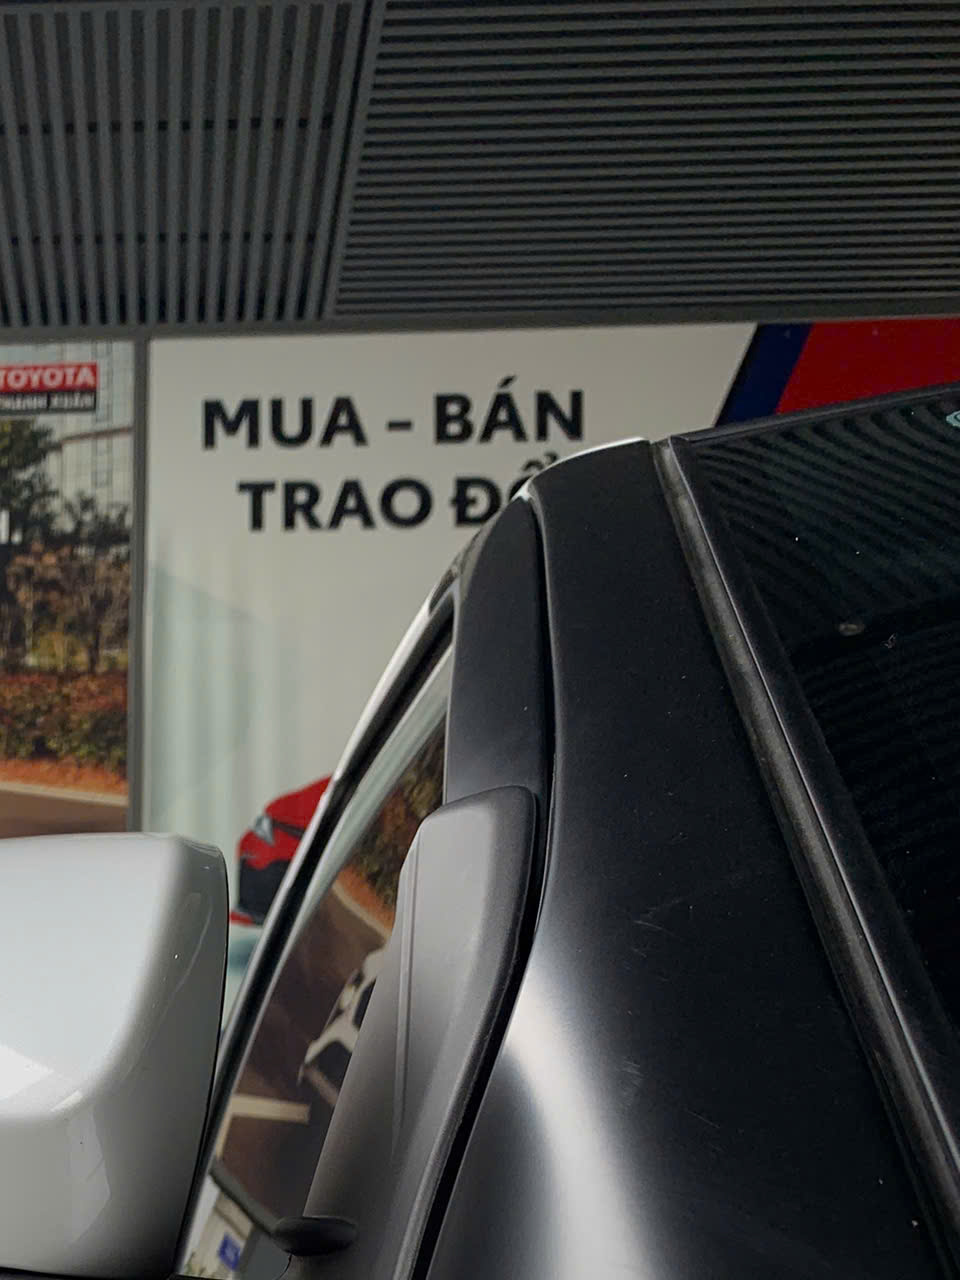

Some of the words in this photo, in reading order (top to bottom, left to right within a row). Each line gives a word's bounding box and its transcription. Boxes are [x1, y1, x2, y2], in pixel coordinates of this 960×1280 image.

[202, 395, 368, 449] MUA
[434, 375, 584, 445] BÁN
[237, 477, 434, 532] TRAO
